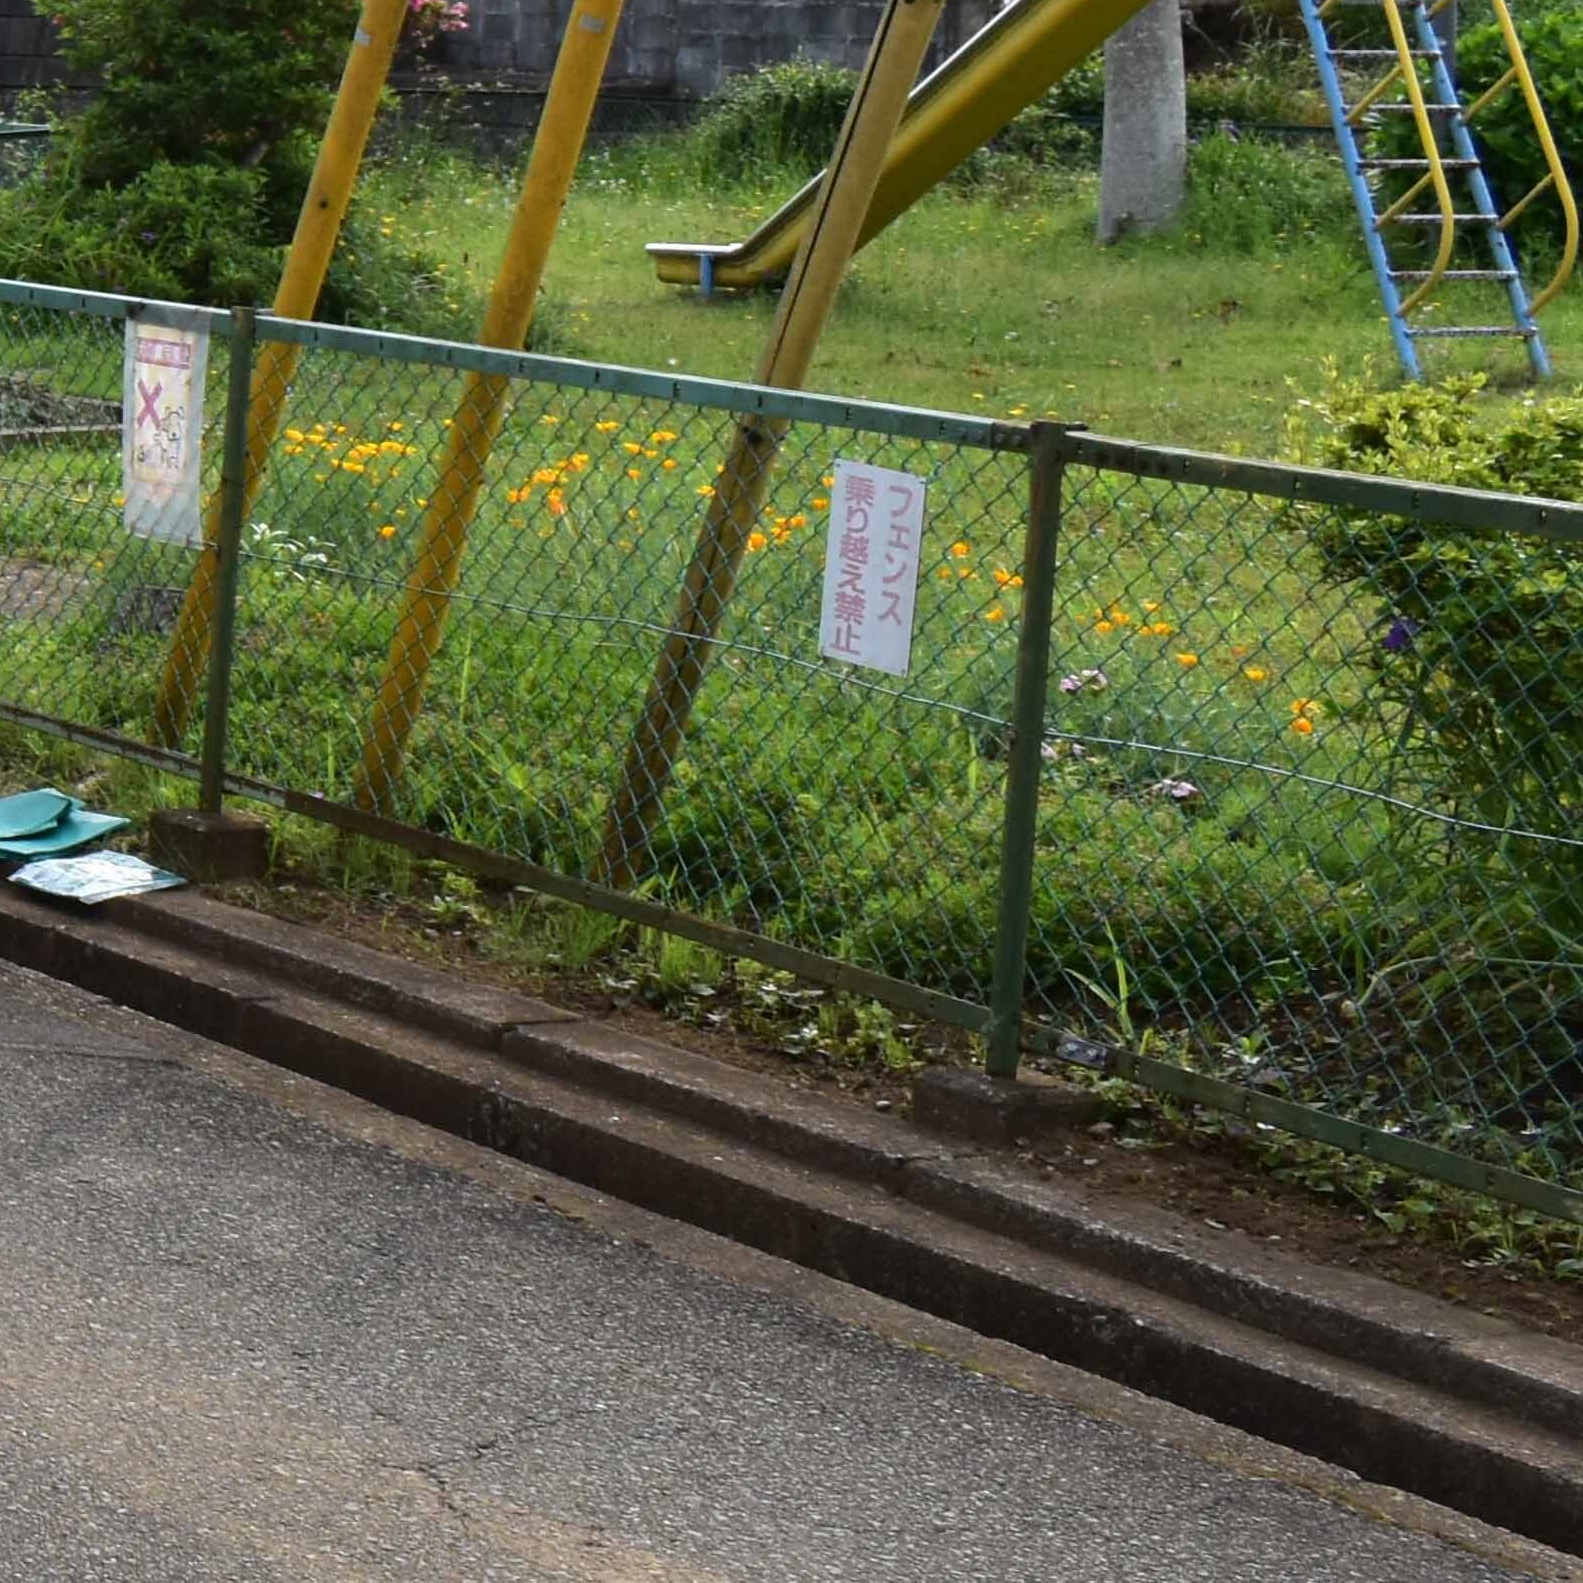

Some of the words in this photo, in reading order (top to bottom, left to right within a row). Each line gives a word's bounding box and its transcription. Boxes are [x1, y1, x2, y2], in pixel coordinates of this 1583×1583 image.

[832, 477, 875, 655] 乗り越え禁止
[879, 484, 913, 626] フェンス
